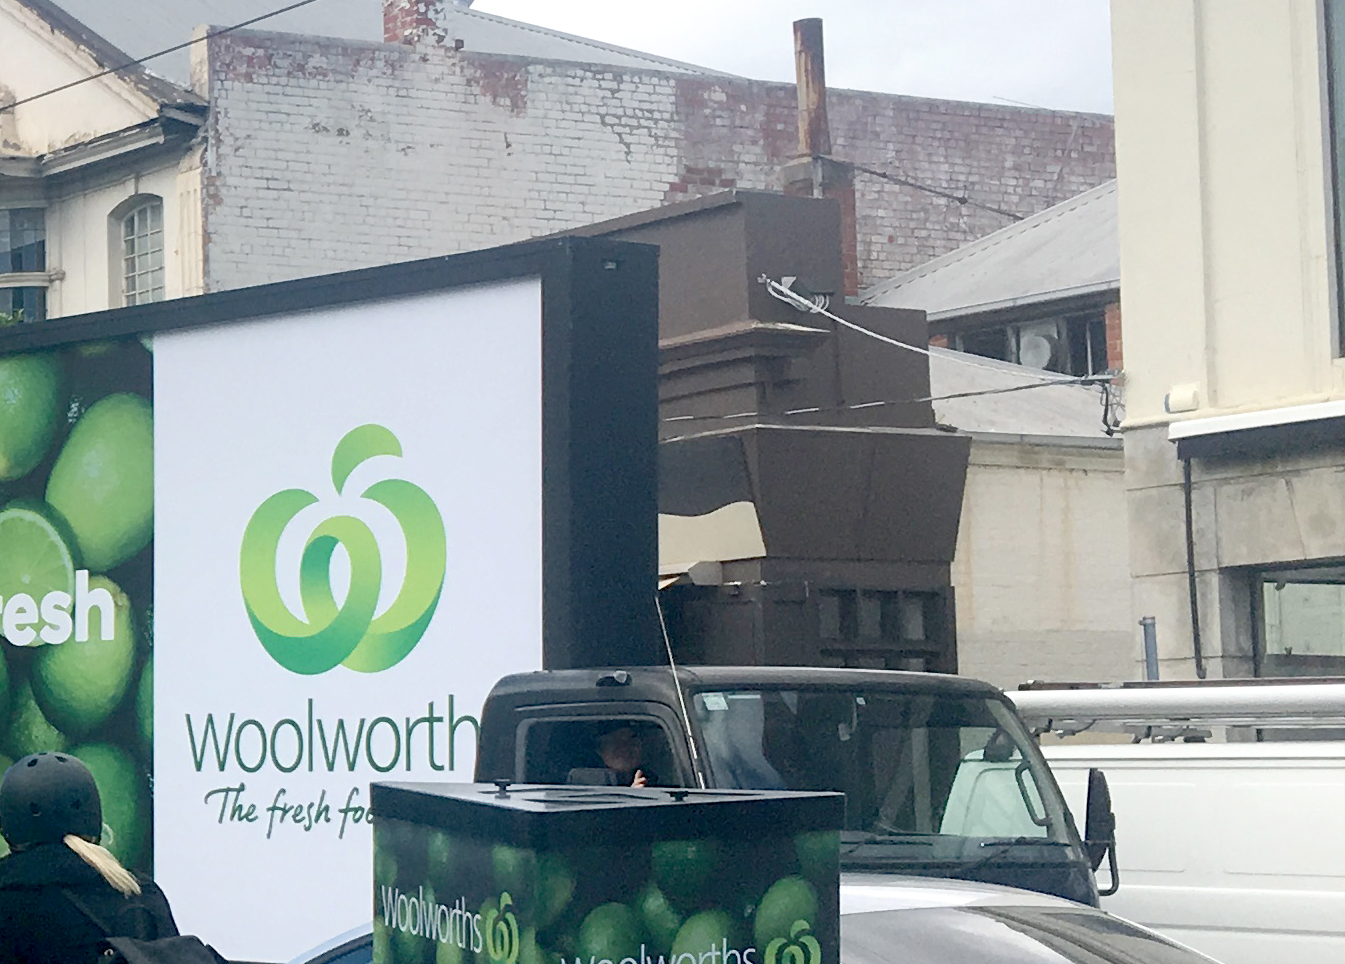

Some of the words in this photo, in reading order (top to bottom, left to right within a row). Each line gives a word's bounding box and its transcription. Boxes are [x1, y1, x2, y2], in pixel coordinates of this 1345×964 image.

[185, 694, 482, 773] Woolworth
[204, 783, 259, 824] The
[266, 788, 332, 839] fresh
[338, 787, 376, 839] foo
[381, 885, 484, 954] Woolworths
